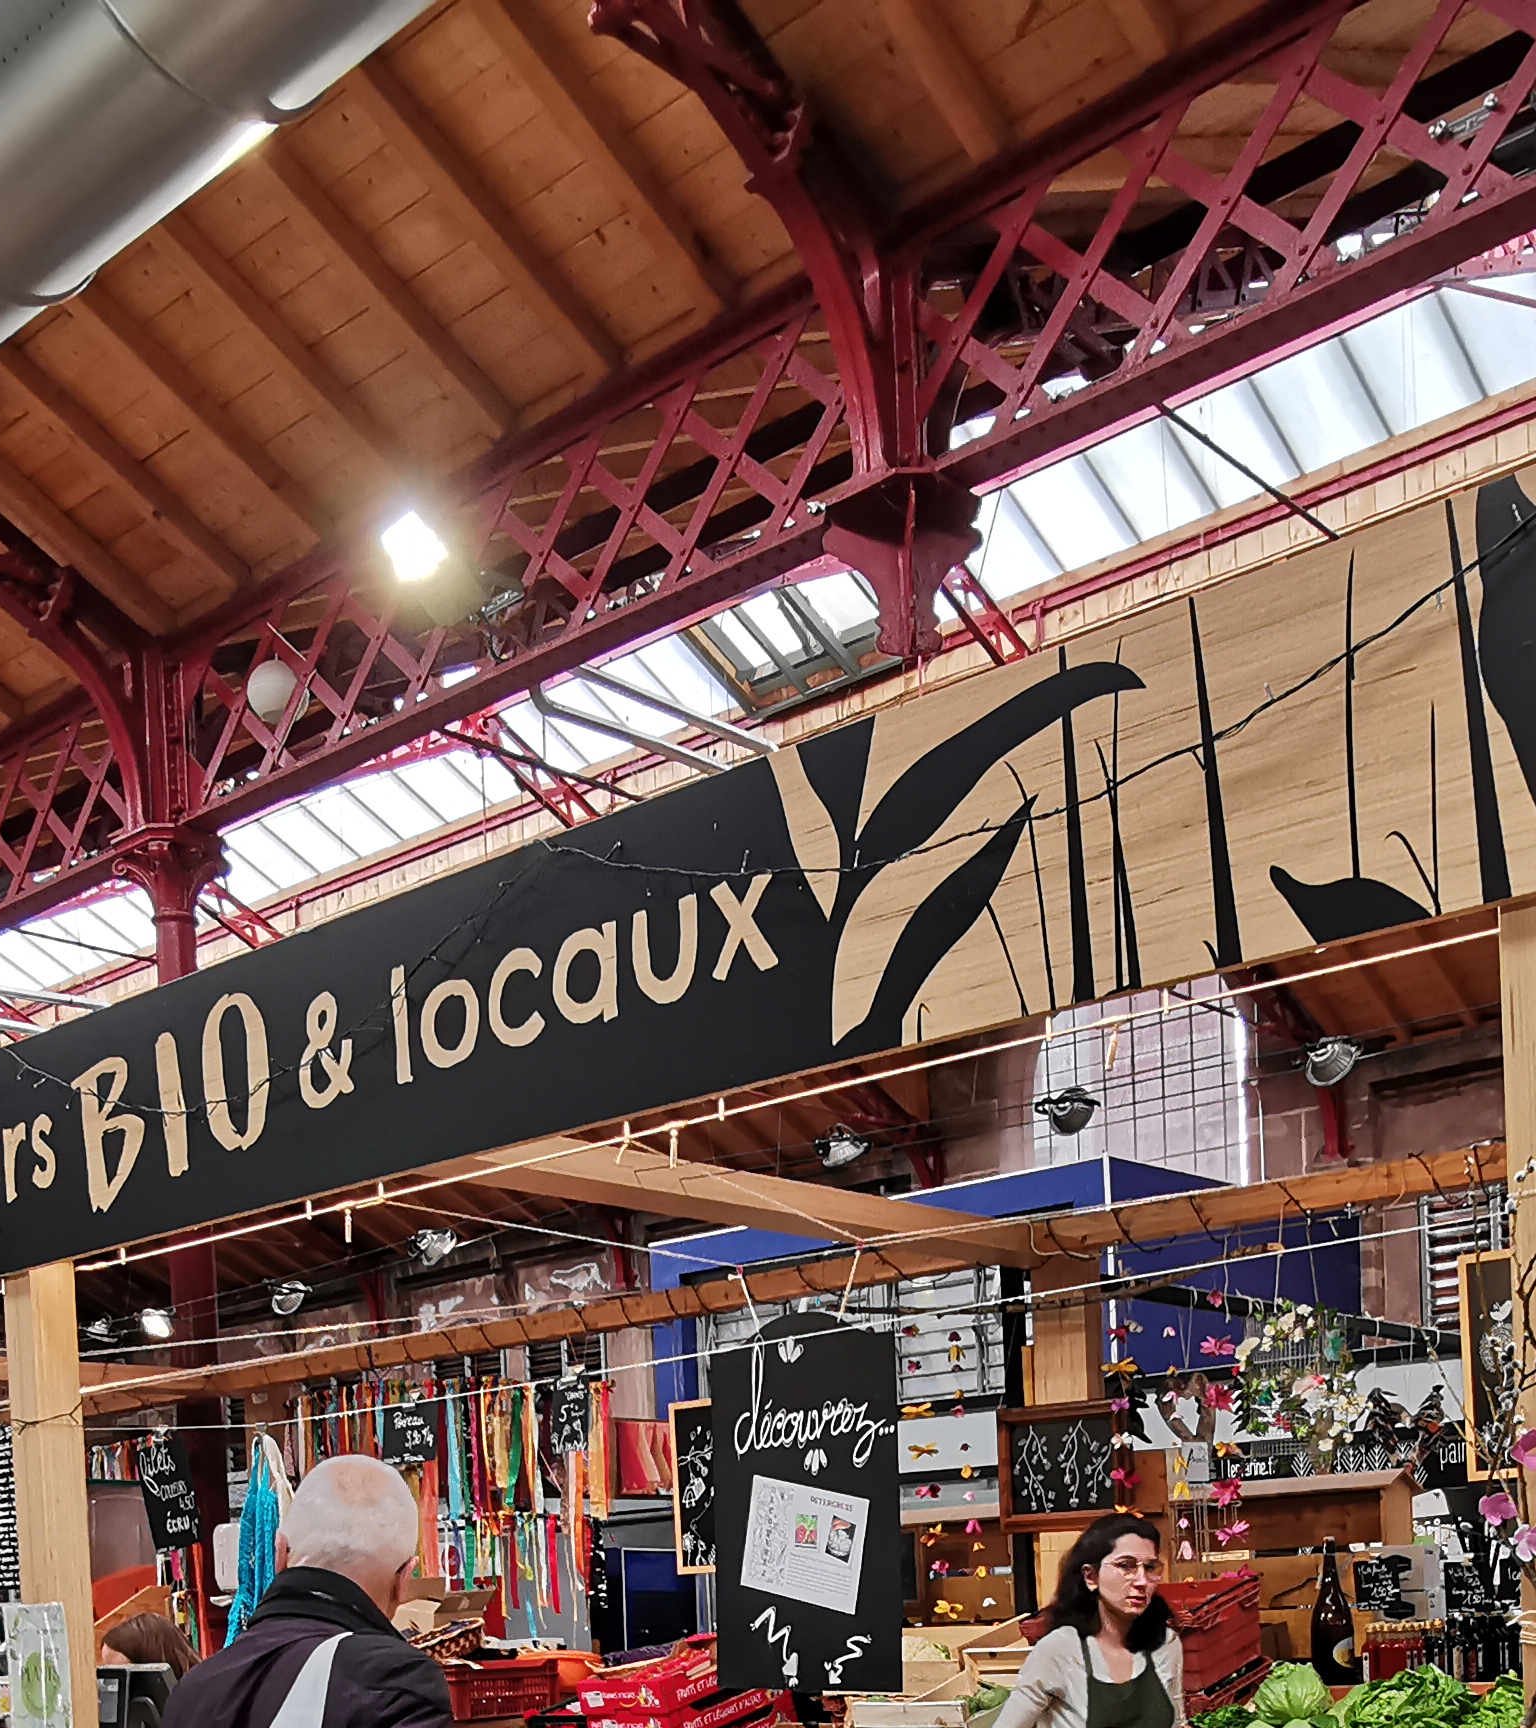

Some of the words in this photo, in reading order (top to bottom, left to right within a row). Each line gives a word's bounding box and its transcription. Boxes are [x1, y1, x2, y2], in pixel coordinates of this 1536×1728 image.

[71, 993, 268, 1213] BIO
[299, 991, 354, 1109] &
[390, 872, 780, 1085] locaux
